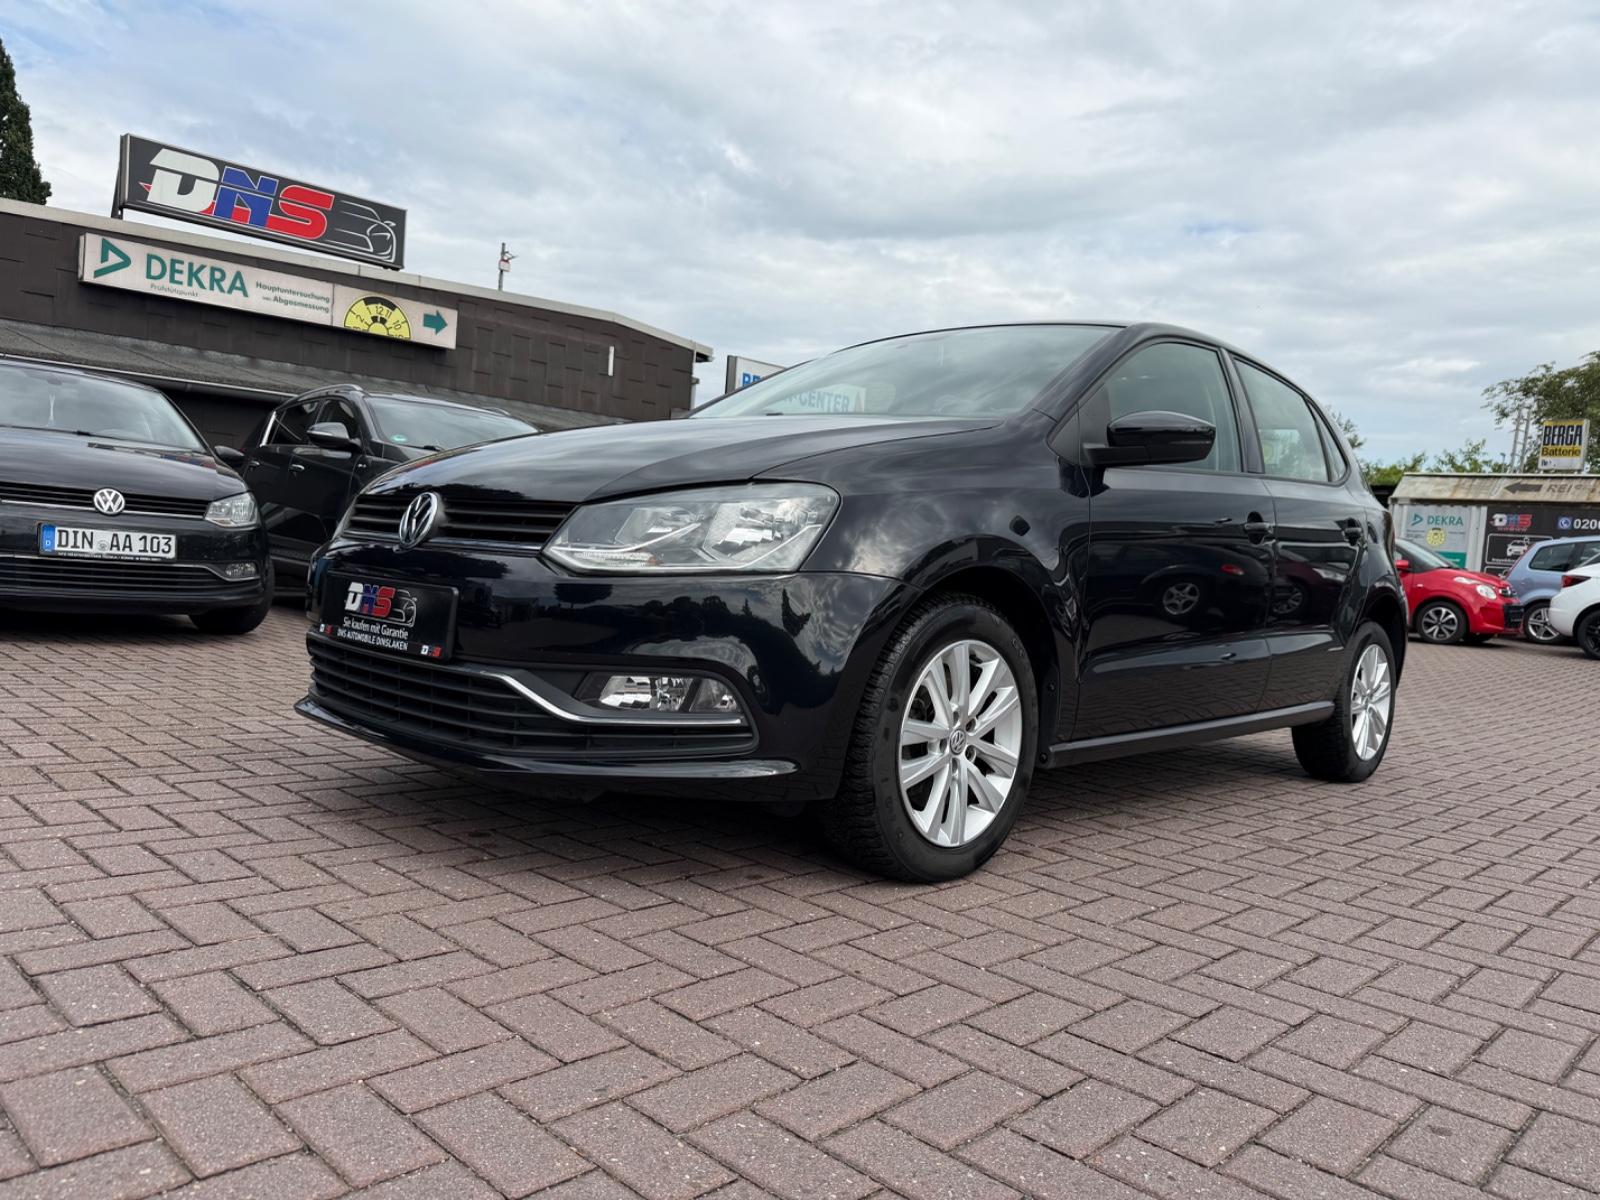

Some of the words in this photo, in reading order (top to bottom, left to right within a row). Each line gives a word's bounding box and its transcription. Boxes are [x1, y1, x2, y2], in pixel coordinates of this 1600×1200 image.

[146, 148, 335, 240] DNS
[145, 253, 249, 298] DEKRA
[800, 390, 850, 414] CENTER
[1542, 425, 1583, 446] BERGA
[1541, 447, 1582, 457] Batterie
[1427, 515, 1464, 526] DEKRA
[57, 529, 94, 550] DIN
[109, 533, 133, 552] AA
[138, 535, 172, 555] 103
[344, 581, 397, 618] DNS
[381, 624, 409, 640] Garantie
